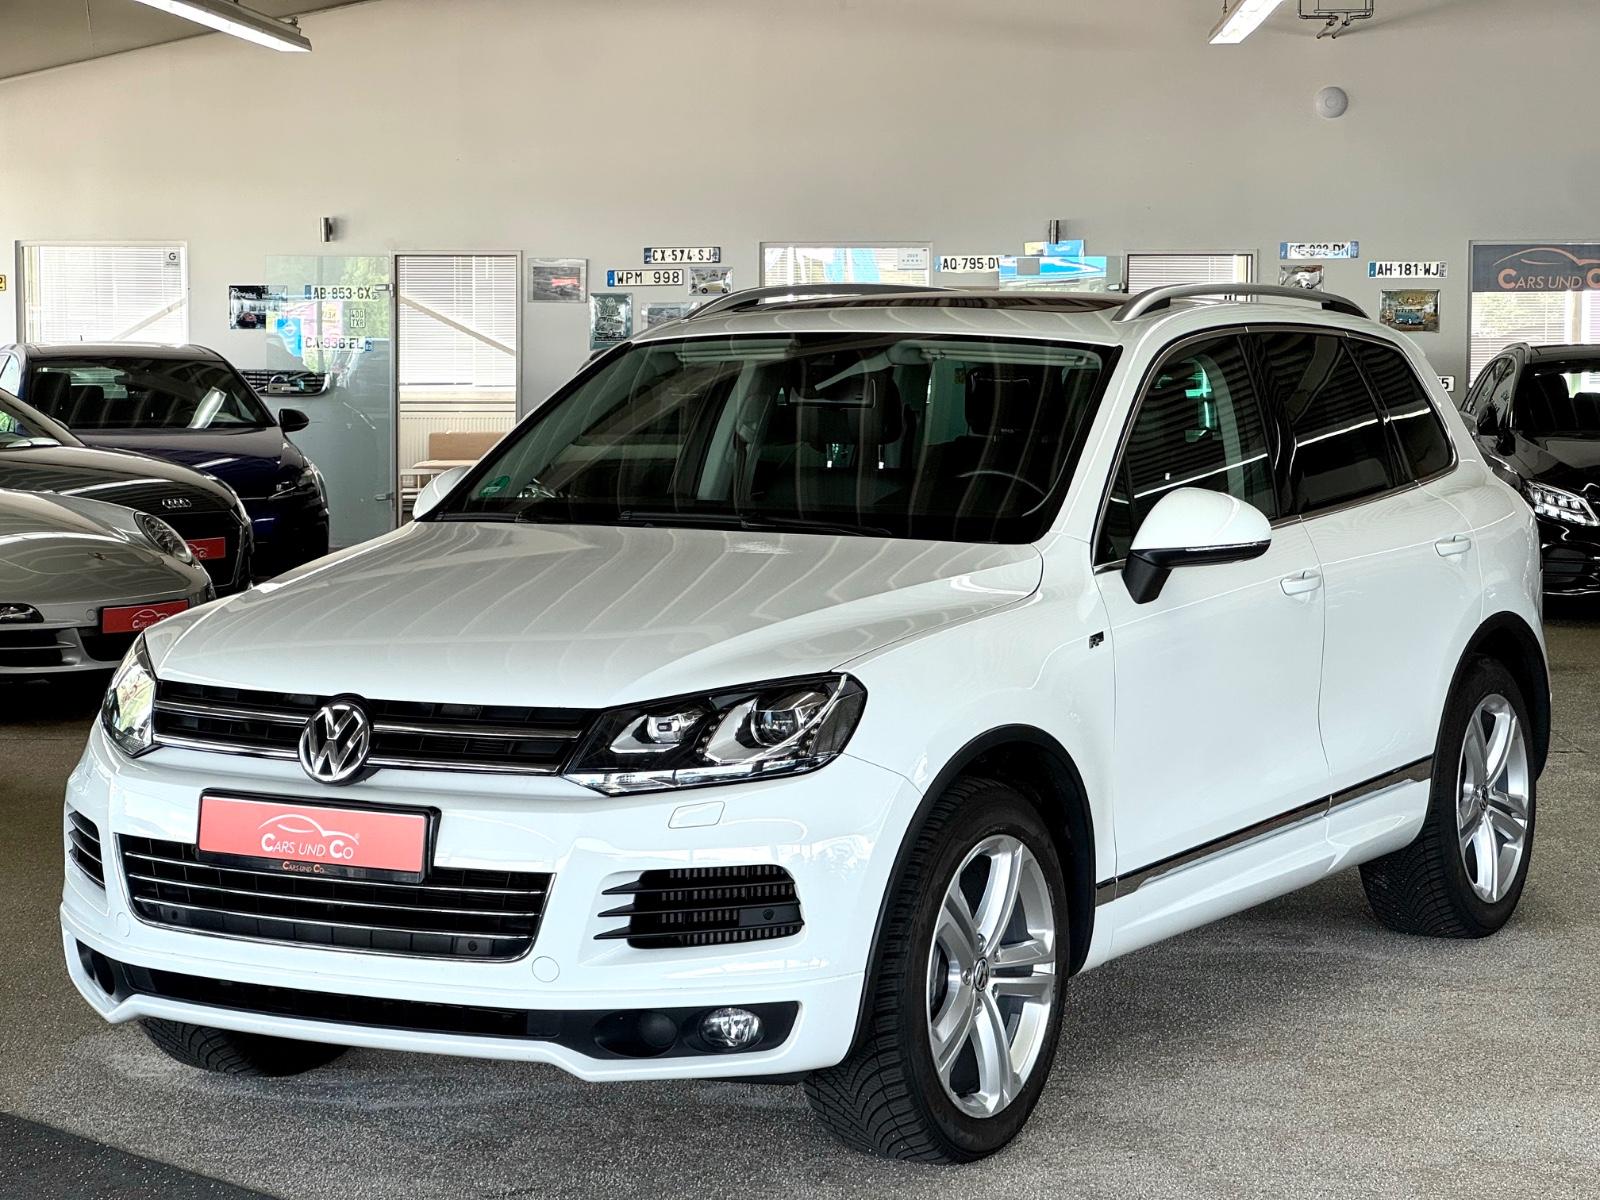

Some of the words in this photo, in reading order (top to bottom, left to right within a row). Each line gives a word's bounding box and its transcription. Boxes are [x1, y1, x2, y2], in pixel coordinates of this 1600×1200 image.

[1377, 263, 1439, 276] AH-181-WJ
[616, 272, 643, 284] WPM
[653, 271, 680, 284] 998
